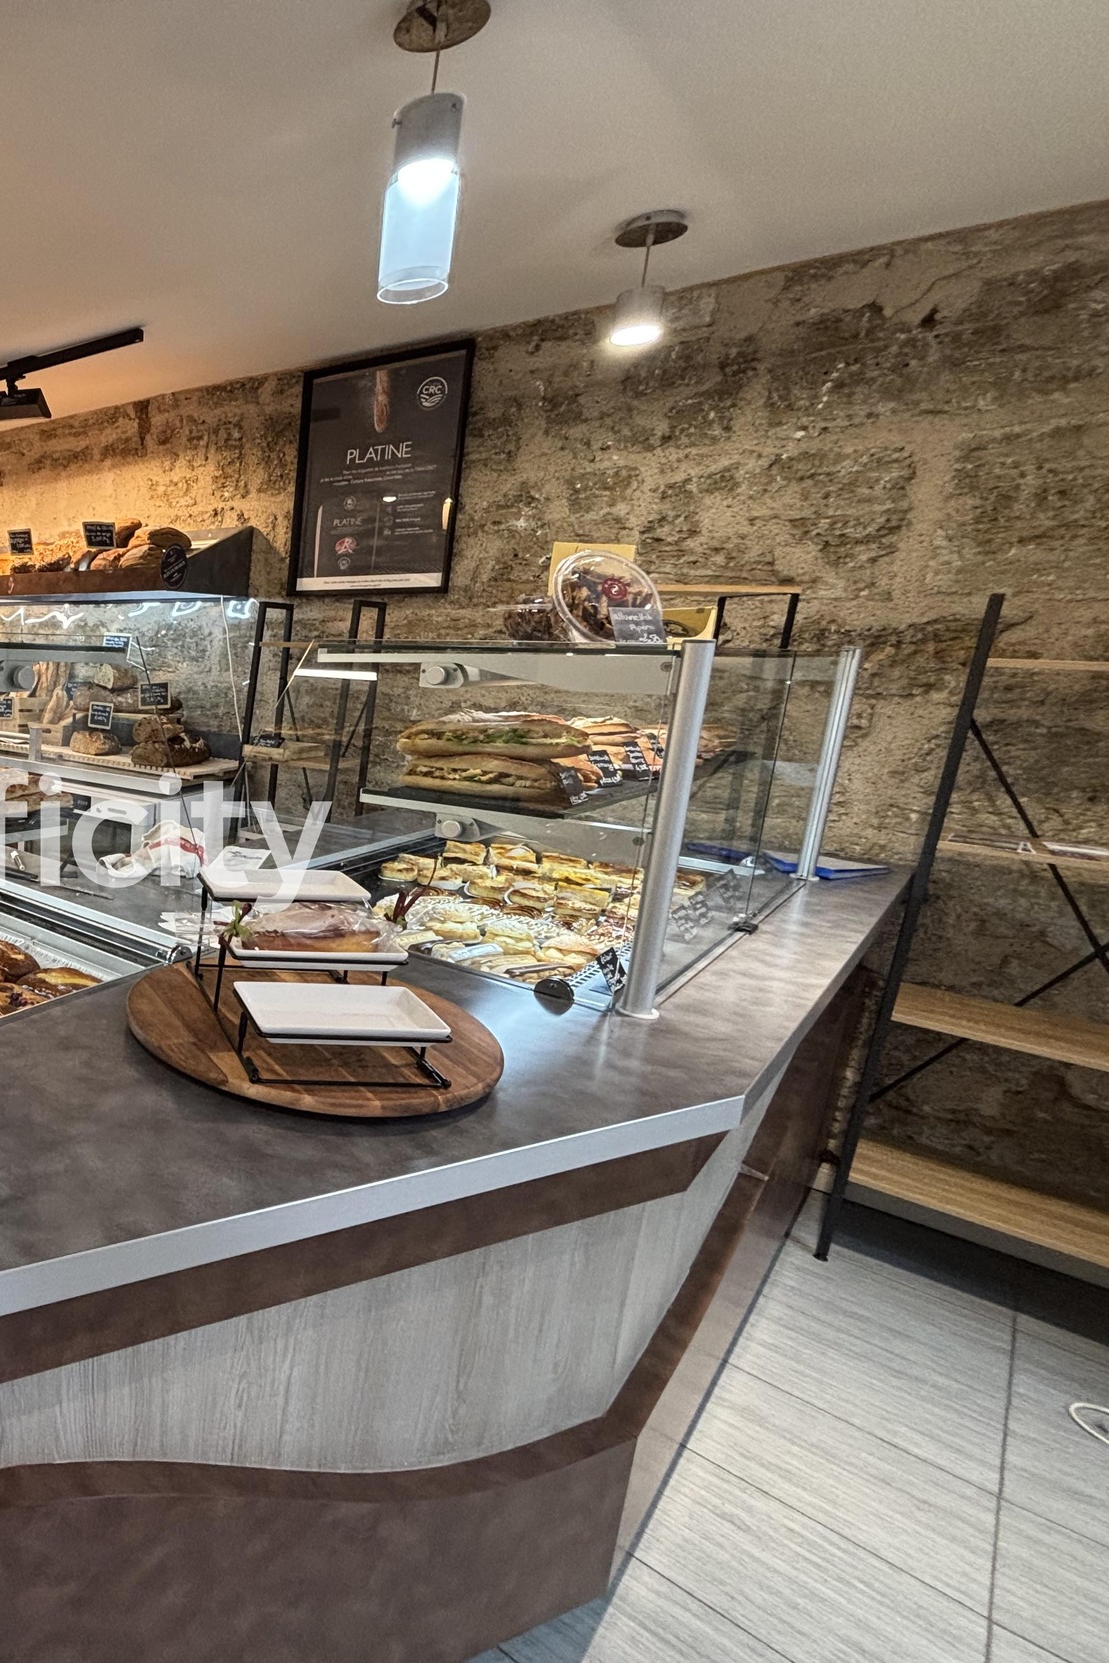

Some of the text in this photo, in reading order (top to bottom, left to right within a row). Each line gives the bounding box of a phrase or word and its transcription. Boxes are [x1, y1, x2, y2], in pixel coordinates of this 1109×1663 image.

[422, 385, 443, 394] CRC
[346, 441, 412, 465] PLATINE
[333, 517, 363, 527] PLATINE
